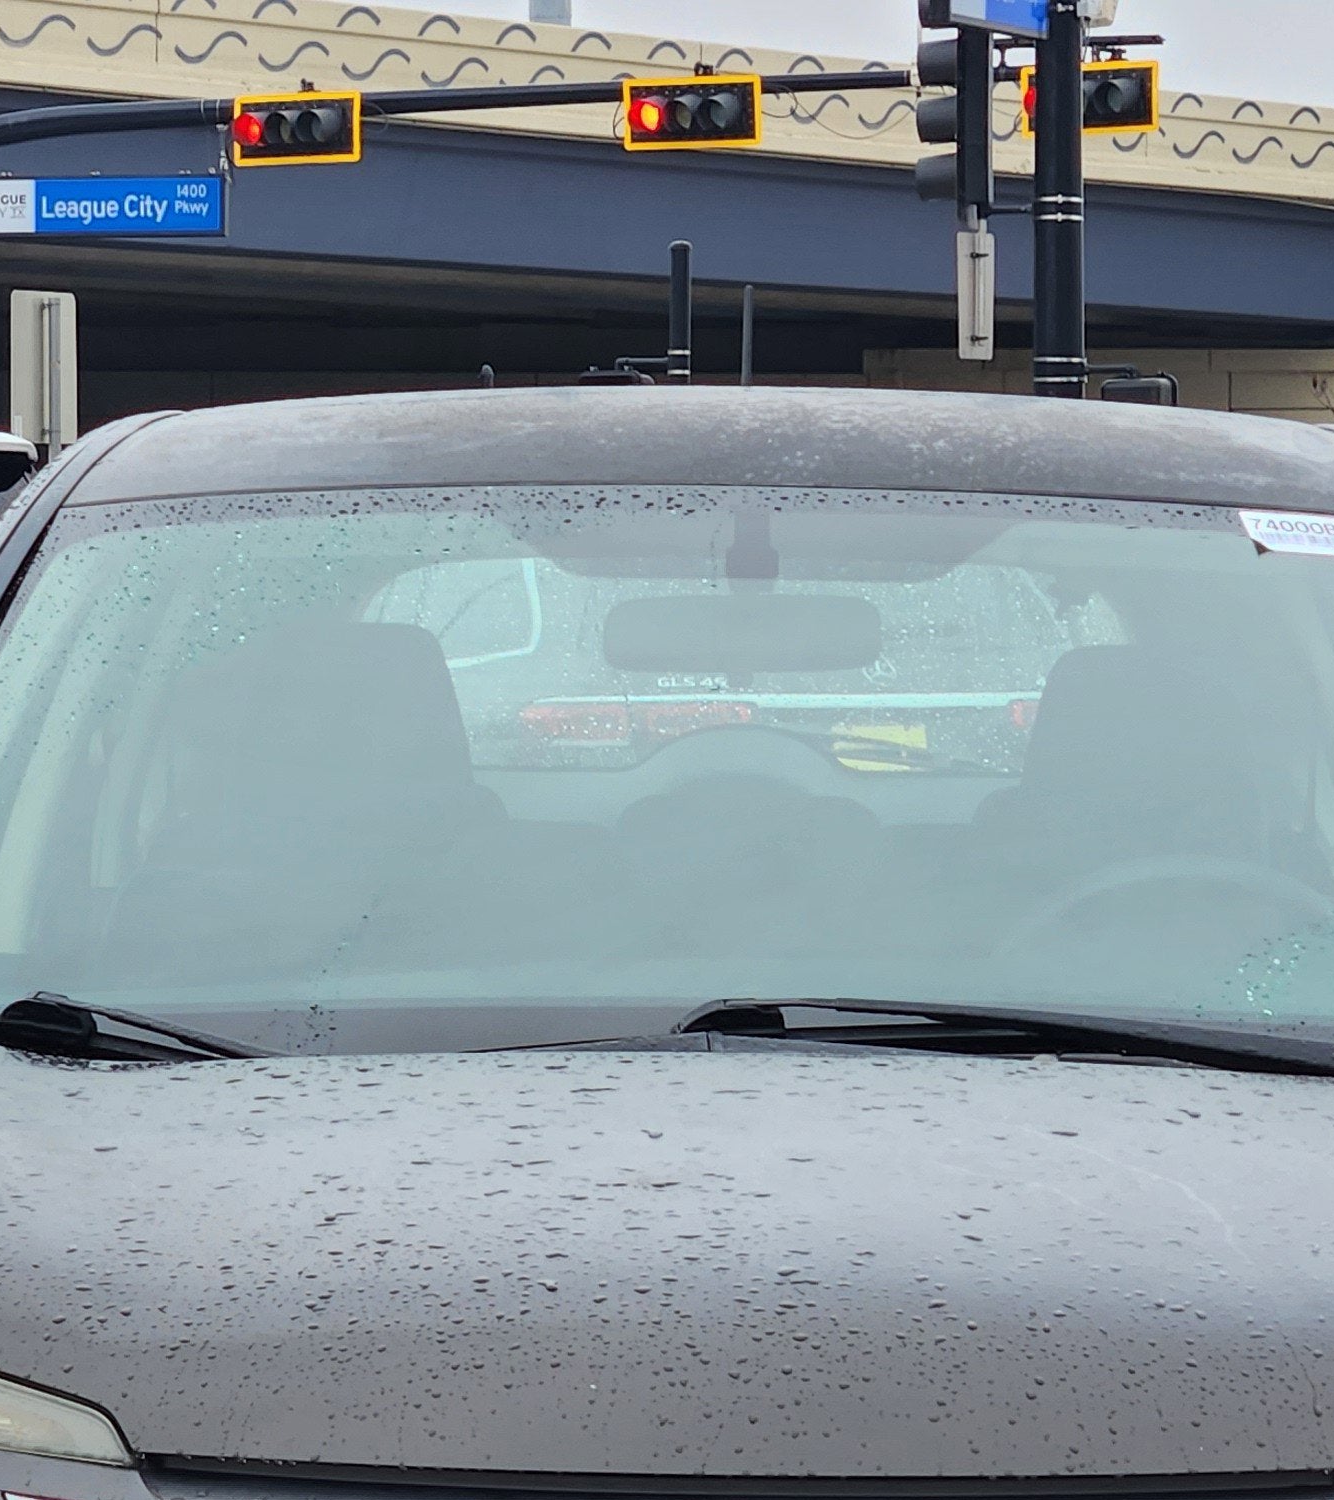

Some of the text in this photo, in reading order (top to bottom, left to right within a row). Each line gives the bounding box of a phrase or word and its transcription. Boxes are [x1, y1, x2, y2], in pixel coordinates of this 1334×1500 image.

[176, 184, 207, 199] 1400
[10, 206, 27, 219] TX
[41, 194, 168, 225] League City
[174, 200, 209, 218] Pkwy
